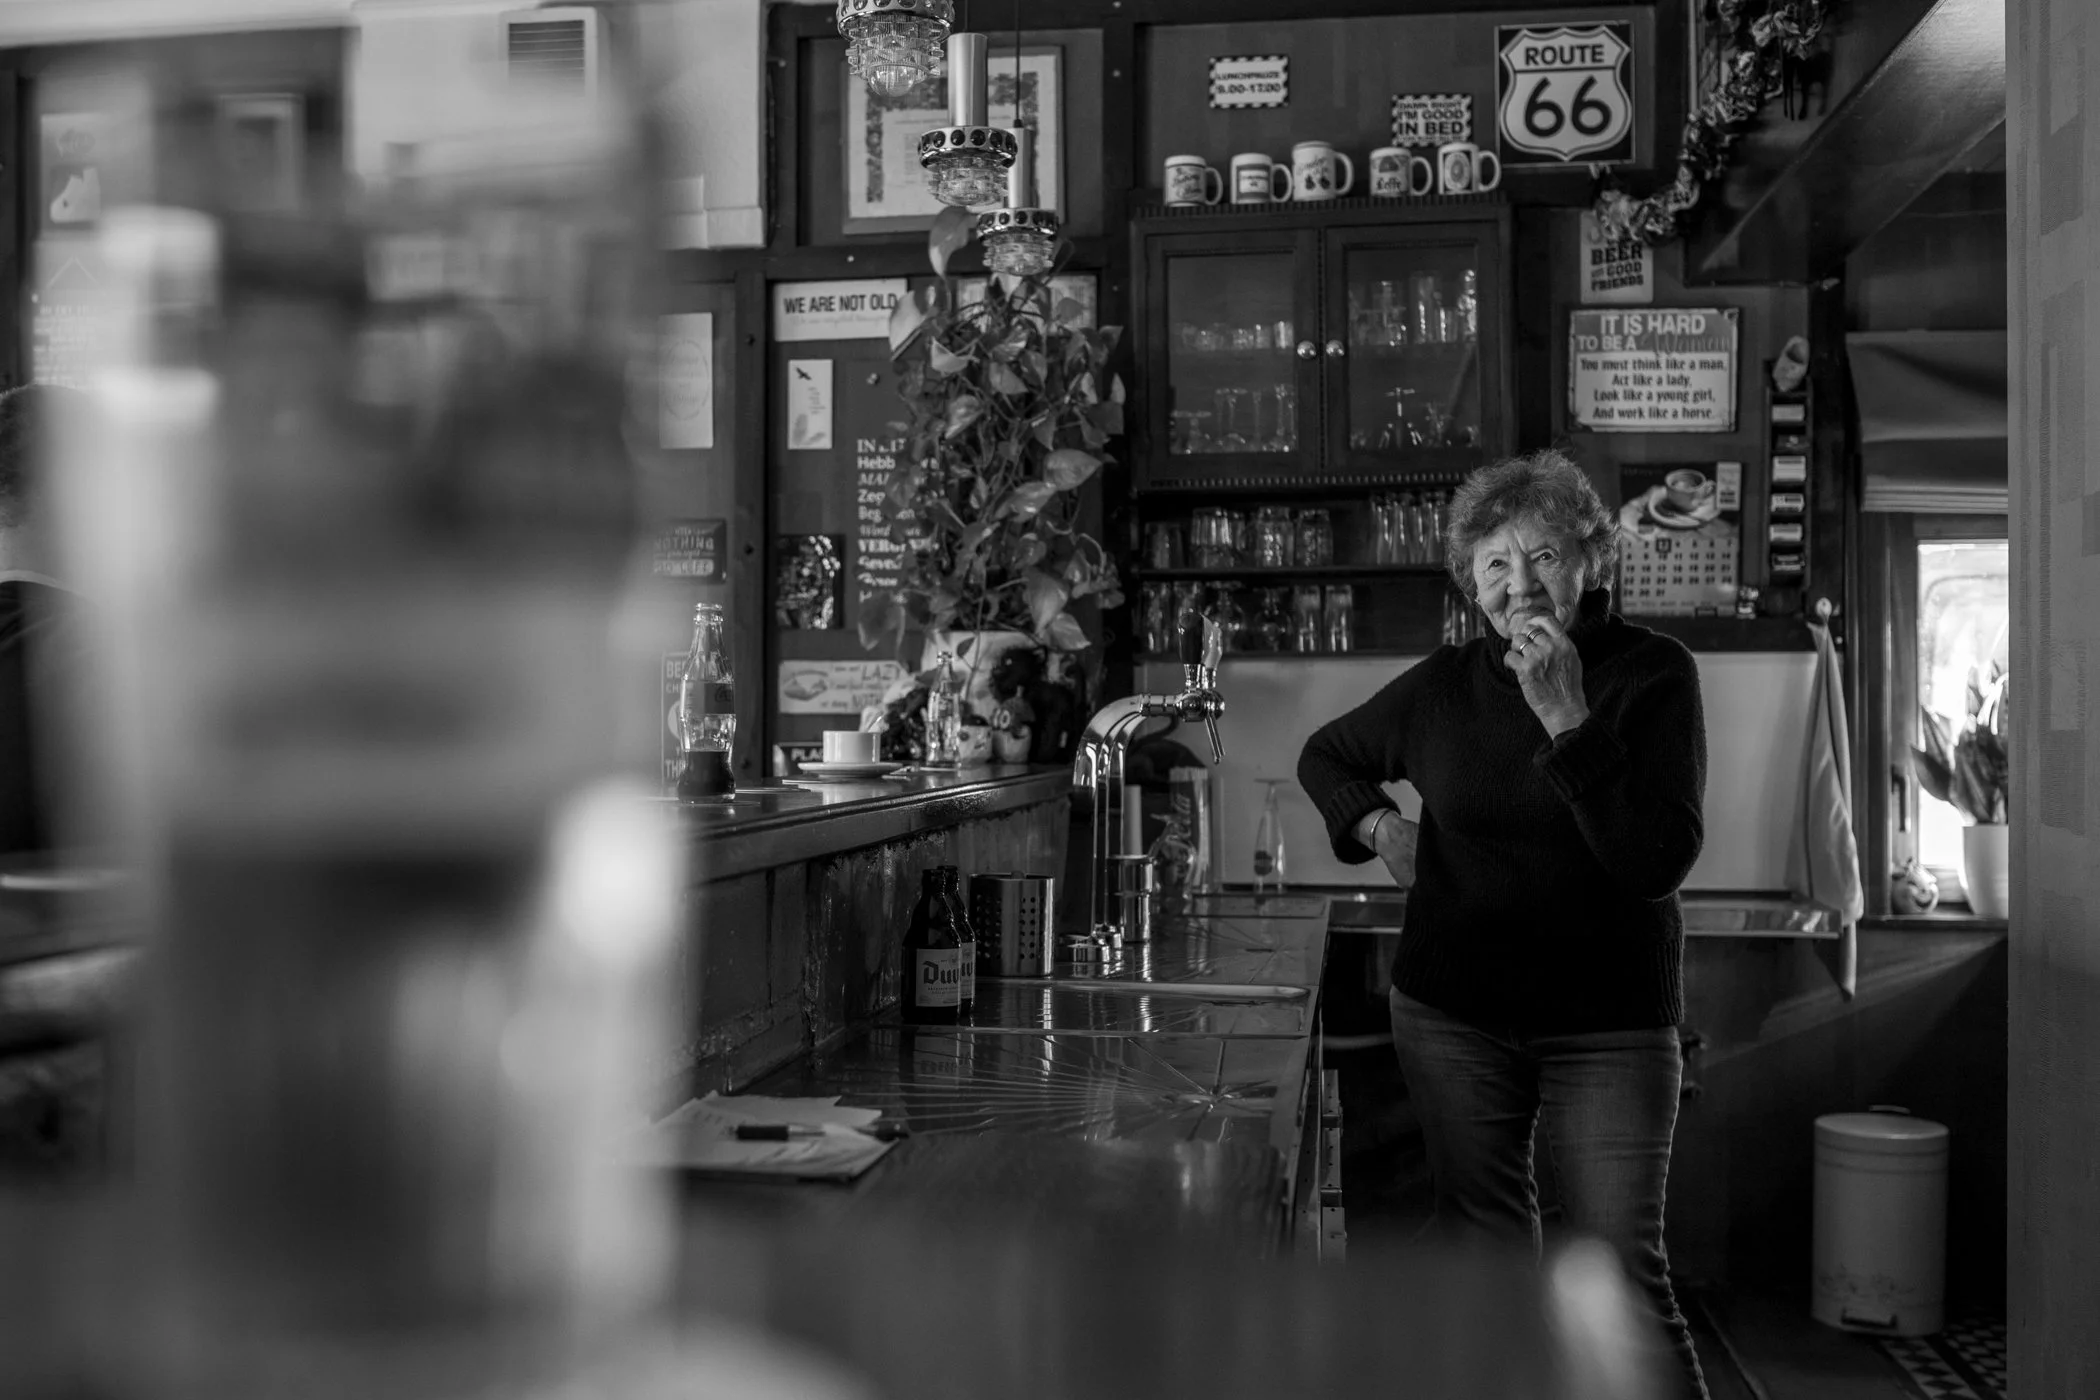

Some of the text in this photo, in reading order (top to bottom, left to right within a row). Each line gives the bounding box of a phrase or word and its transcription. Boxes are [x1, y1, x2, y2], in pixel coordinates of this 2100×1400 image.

[1525, 44, 1604, 66] ROUTE
[1524, 75, 1613, 138] 66
[1422, 109, 1464, 120] GOOD
[1399, 121, 1464, 135] IN BED
[1591, 241, 1643, 266] BEER
[784, 293, 898, 314] WE ARE NOT OLD
[1600, 315, 1706, 335] IT IS HARD
[1577, 335, 1598, 351] TO
[1602, 335, 1622, 351] BE
[1625, 335, 1637, 351] A
[1580, 358, 1598, 371] You
[1601, 359, 1628, 371] must
[1632, 357, 1662, 371] think
[1666, 357, 1685, 370] like
[1689, 361, 1696, 370] a
[1611, 373, 1628, 386] Act
[1633, 373, 1652, 385] like
[1656, 377, 1663, 386] a
[1593, 389, 1619, 402] Look
[1623, 388, 1643, 401] like
[1647, 392, 1653, 401] a
[1656, 391, 1689, 404] young
[1592, 407, 1614, 419] And
[1617, 407, 1645, 419] work
[1648, 406, 1668, 419] like
[1671, 410, 1678, 419] a
[857, 438, 876, 453] IN
[857, 455, 896, 470] Hebb
